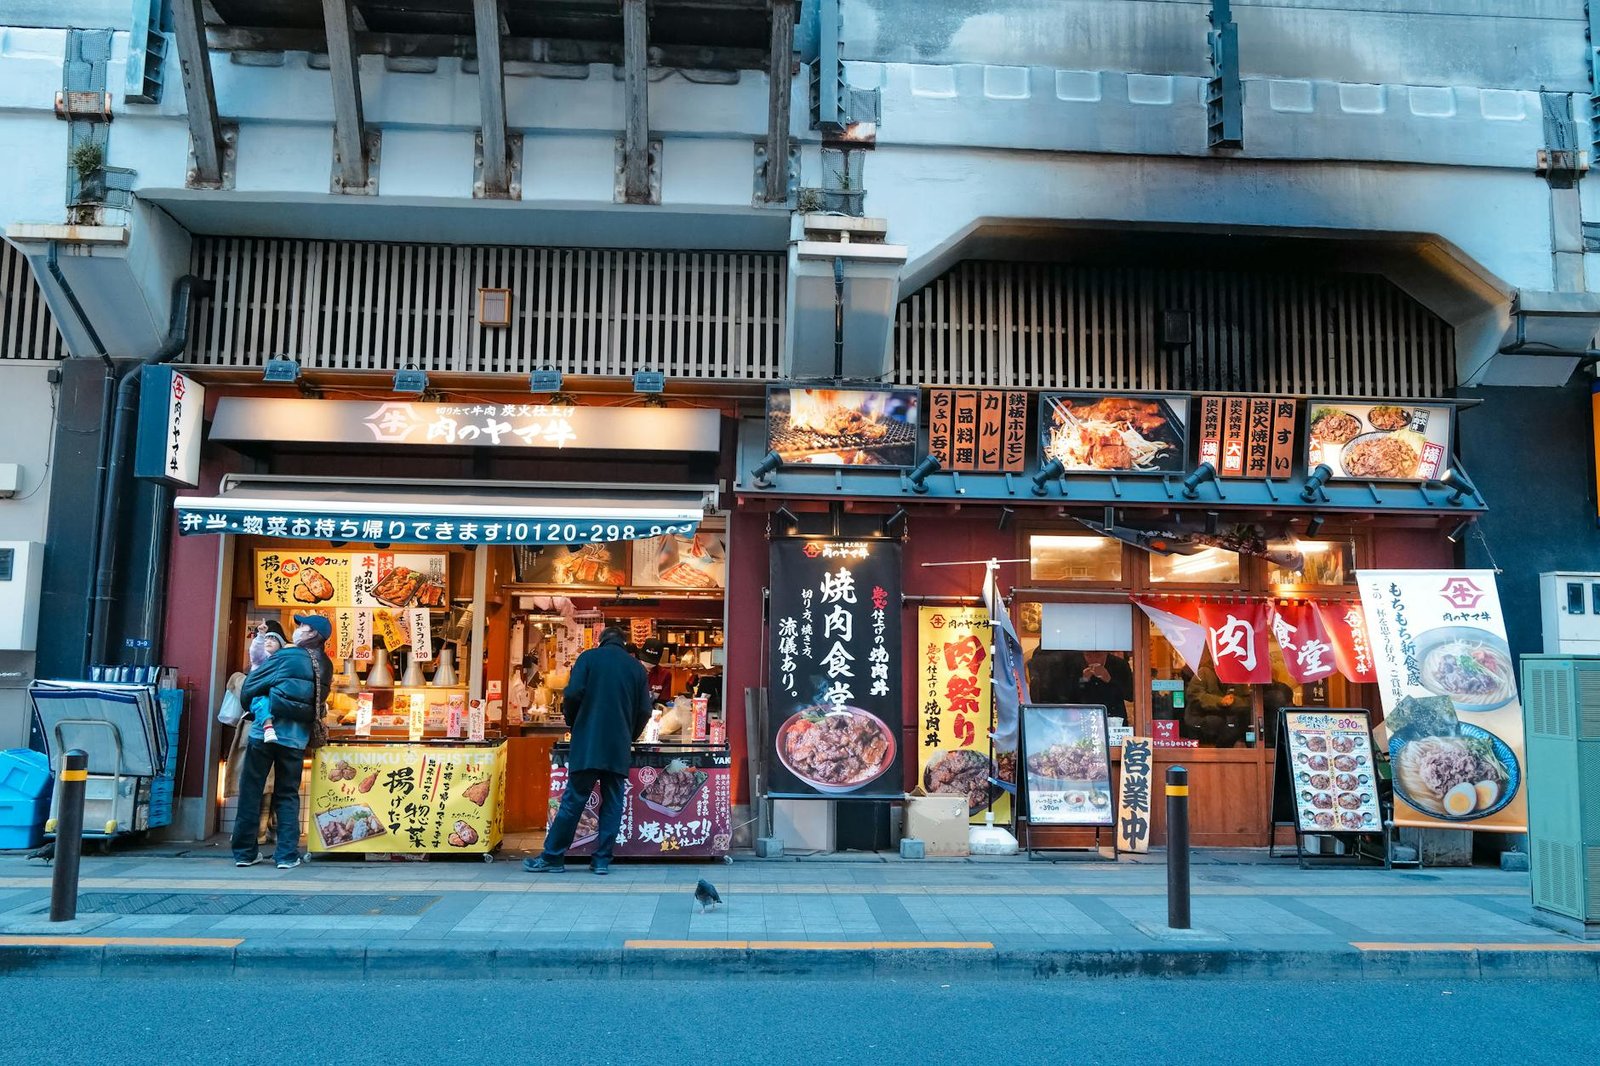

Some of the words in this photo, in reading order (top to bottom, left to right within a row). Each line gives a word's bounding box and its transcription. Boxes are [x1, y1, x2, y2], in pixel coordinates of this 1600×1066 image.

[169, 401, 182, 474] 肉のヤマ牛
[426, 416, 577, 450] 肉のヤマ牛
[500, 404, 576, 417] 炭火仕上げ
[931, 392, 949, 464] ちょい呑み
[955, 393, 975, 464] 一品料理
[981, 393, 1000, 465] カルビ
[1006, 393, 1026, 465] 鉄板ホルモン
[1204, 399, 1219, 439] 炭火焼肉丼
[1228, 399, 1243, 439] 炭火焼肉丼
[1249, 400, 1270, 472] 炭火焼肉丼
[1274, 400, 1294, 470] 肉すい
[260, 554, 281, 595] 揚げたて
[299, 556, 315, 566] We
[361, 555, 376, 594] 牛カルビ
[822, 547, 870, 560] 肉のヤマ牛
[801, 588, 814, 660] 切り方、焼き方、
[818, 566, 858, 718] 焼肉食堂
[867, 585, 890, 697] 炭火仕上げの焼肉丼
[948, 619, 993, 630] 肉のヤマ牛
[1388, 582, 1425, 688] もちもち新食感
[1442, 611, 1492, 622] 肉のヤマ牛
[355, 651, 370, 659] 250
[415, 651, 429, 659] 120
[778, 615, 799, 698] 流儀あり。
[923, 643, 942, 748] 炭火仕上げの焼肉丼
[943, 634, 987, 748] 肉祭り
[320, 751, 401, 765] YAKINIKU
[382, 766, 415, 836] 揚げたて
[403, 802, 431, 849] 惣菜
[430, 762, 454, 849] お持ち帰りできます
[1121, 739, 1152, 850] 営業中
